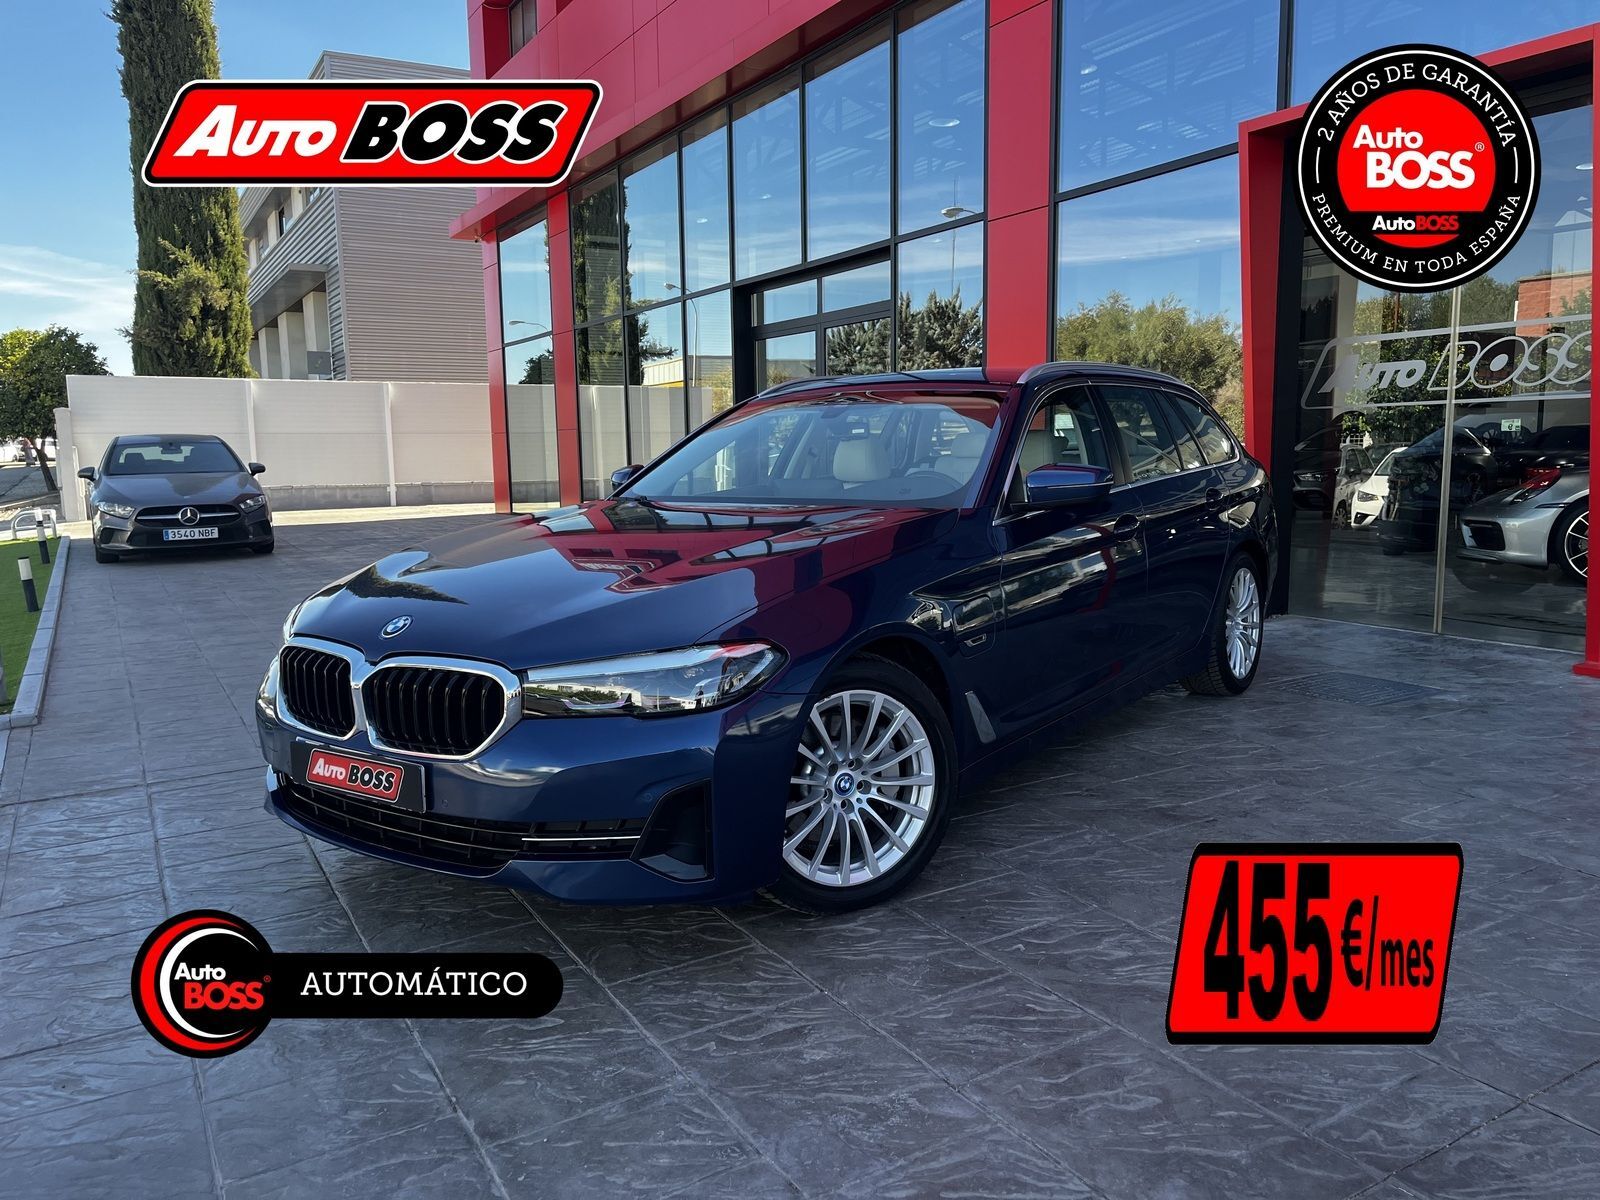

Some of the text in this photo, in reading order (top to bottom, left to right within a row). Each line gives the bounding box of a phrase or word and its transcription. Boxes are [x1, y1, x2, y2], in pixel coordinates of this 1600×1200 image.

[171, 528, 216, 539] 3540 NBF
[347, 764, 396, 793] BOSS
